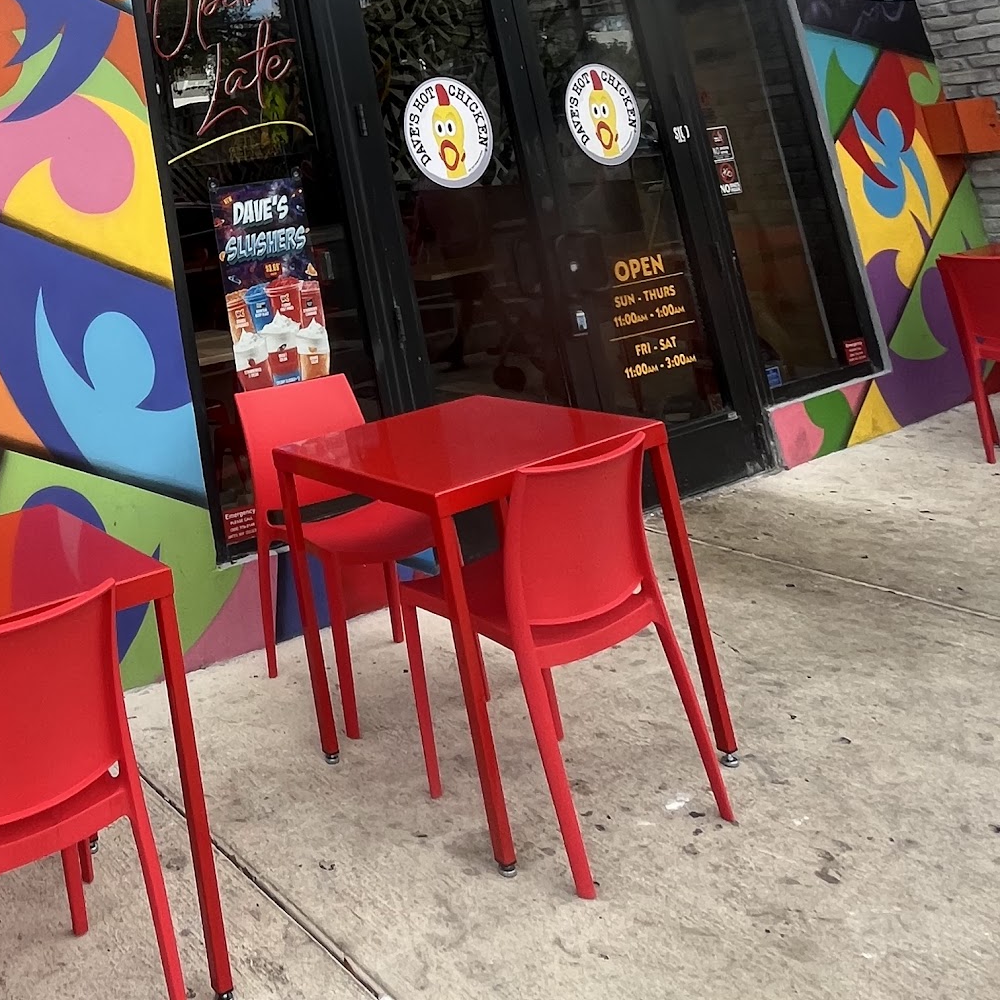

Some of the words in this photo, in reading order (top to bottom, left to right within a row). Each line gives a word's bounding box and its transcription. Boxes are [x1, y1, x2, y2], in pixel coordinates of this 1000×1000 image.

[197, 19, 297, 136] Late
[572, 73, 591, 95] HOT
[413, 86, 436, 113] HOT
[600, 71, 637, 129] CHICKEN
[448, 85, 489, 147] CHICKEN
[569, 96, 590, 146] DAVE'S
[409, 113, 432, 167] DAVE'S
[232, 194, 289, 226] DAVE'S
[225, 225, 307, 263] SLUSHERS
[614, 253, 665, 282] OPEN
[614, 293, 636, 308] SUN
[643, 285, 676, 302] THURS
[635, 342, 652, 357] FRI
[659, 336, 677, 351] SAT
[225, 508, 256, 520] Emergency
